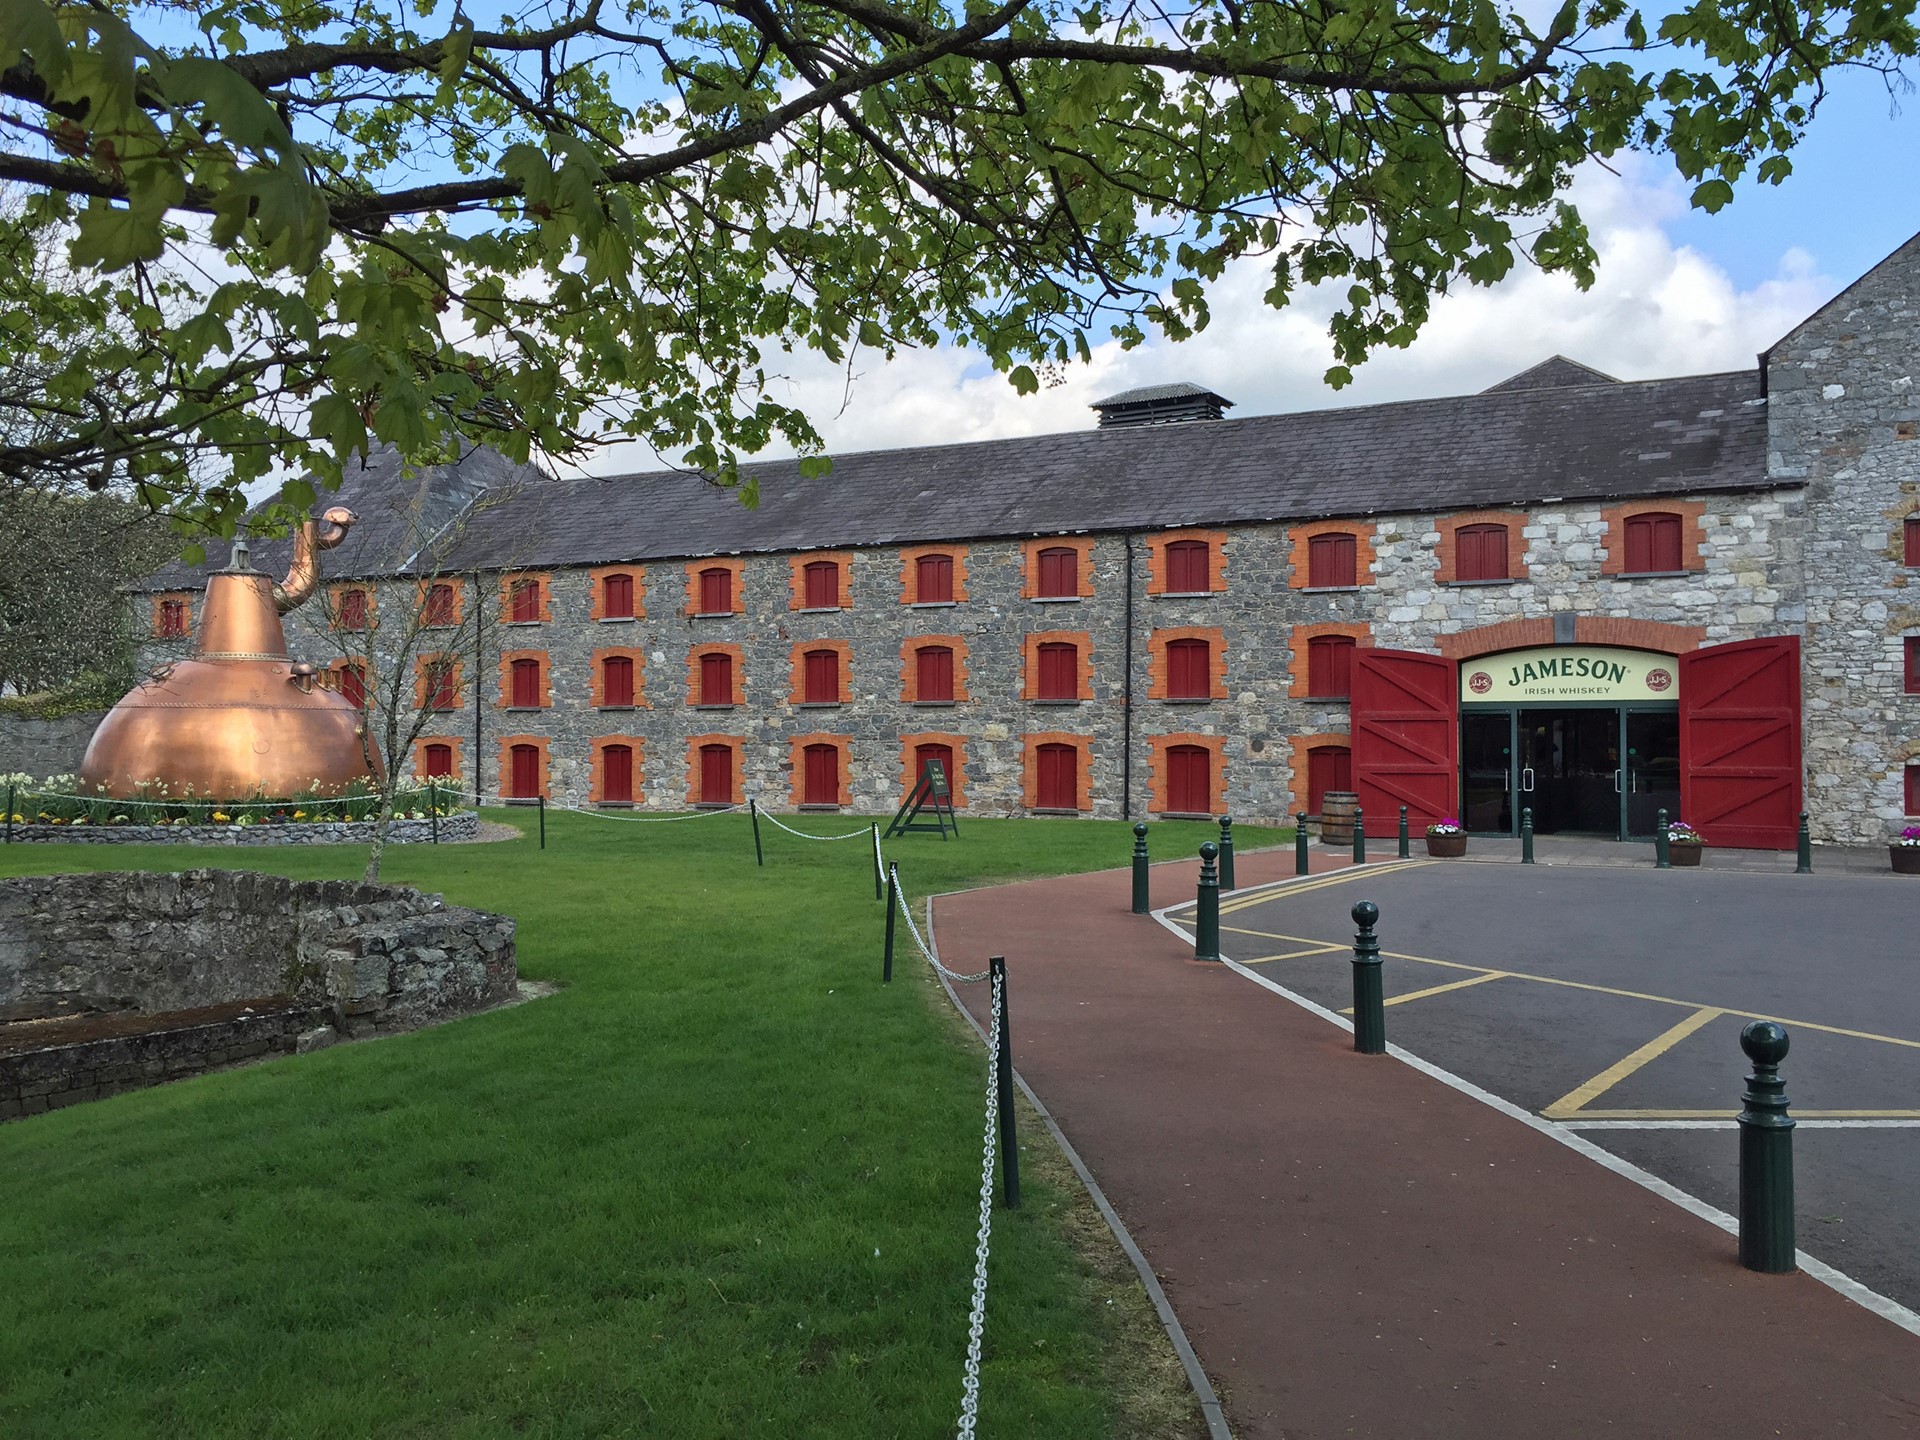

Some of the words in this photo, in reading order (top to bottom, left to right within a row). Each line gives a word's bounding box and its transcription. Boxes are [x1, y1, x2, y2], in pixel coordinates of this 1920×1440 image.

[1508, 658, 1627, 686] JAMESON
[1524, 687, 1555, 695] IRISH
[1558, 686, 1611, 694] WHISKEY
